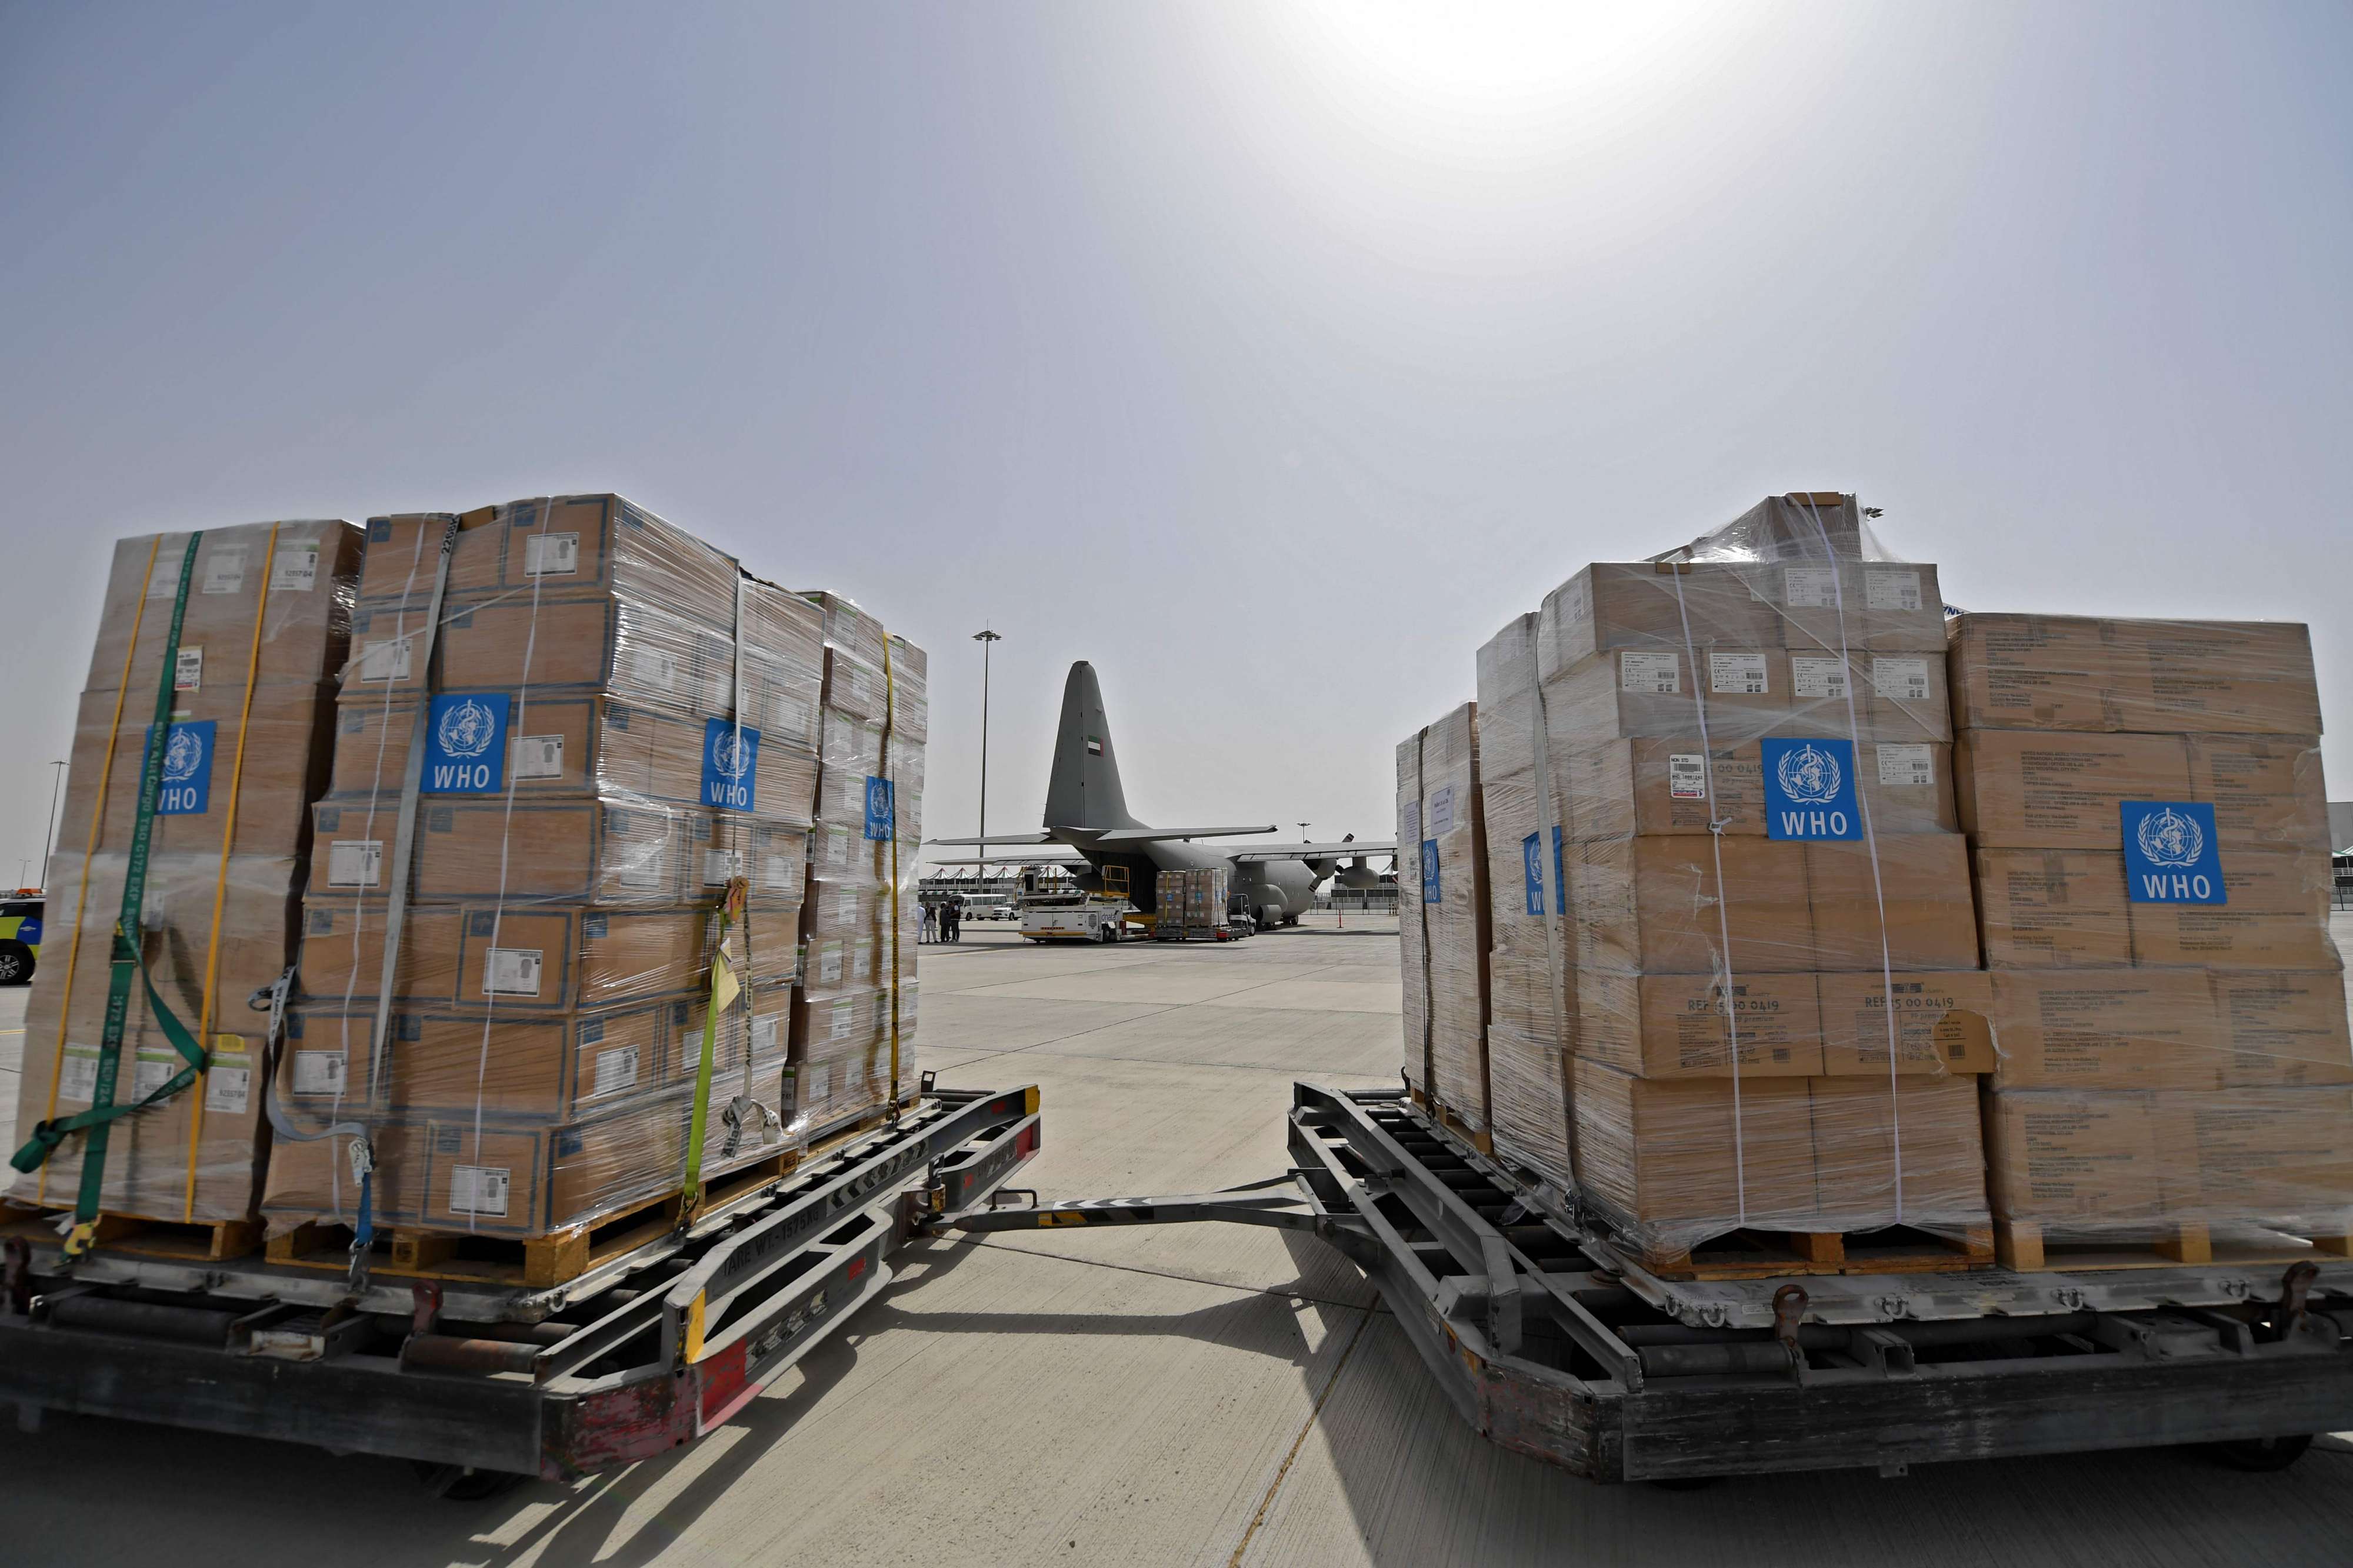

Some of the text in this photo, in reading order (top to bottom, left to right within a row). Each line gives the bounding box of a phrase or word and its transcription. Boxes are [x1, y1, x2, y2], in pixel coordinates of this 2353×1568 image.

[435, 765, 489, 788] WHO
[141, 775, 159, 812] Cargo
[711, 782, 747, 806] WHO
[871, 822, 890, 838] WHO
[1782, 812, 1847, 835] WHO
[133, 844, 146, 873] C172
[129, 877, 142, 901] EXP
[2143, 875, 2210, 899] WHO
[1101, 913, 1116, 921] dnata
[1750, 1000, 1779, 1011] 0419
[1865, 997, 1887, 1007] REF
[1906, 998, 1921, 1007] 00
[1926, 997, 1954, 1009] 0419
[98, 1058, 115, 1104] SEP/24
[721, 1122, 740, 1157] Atlas
